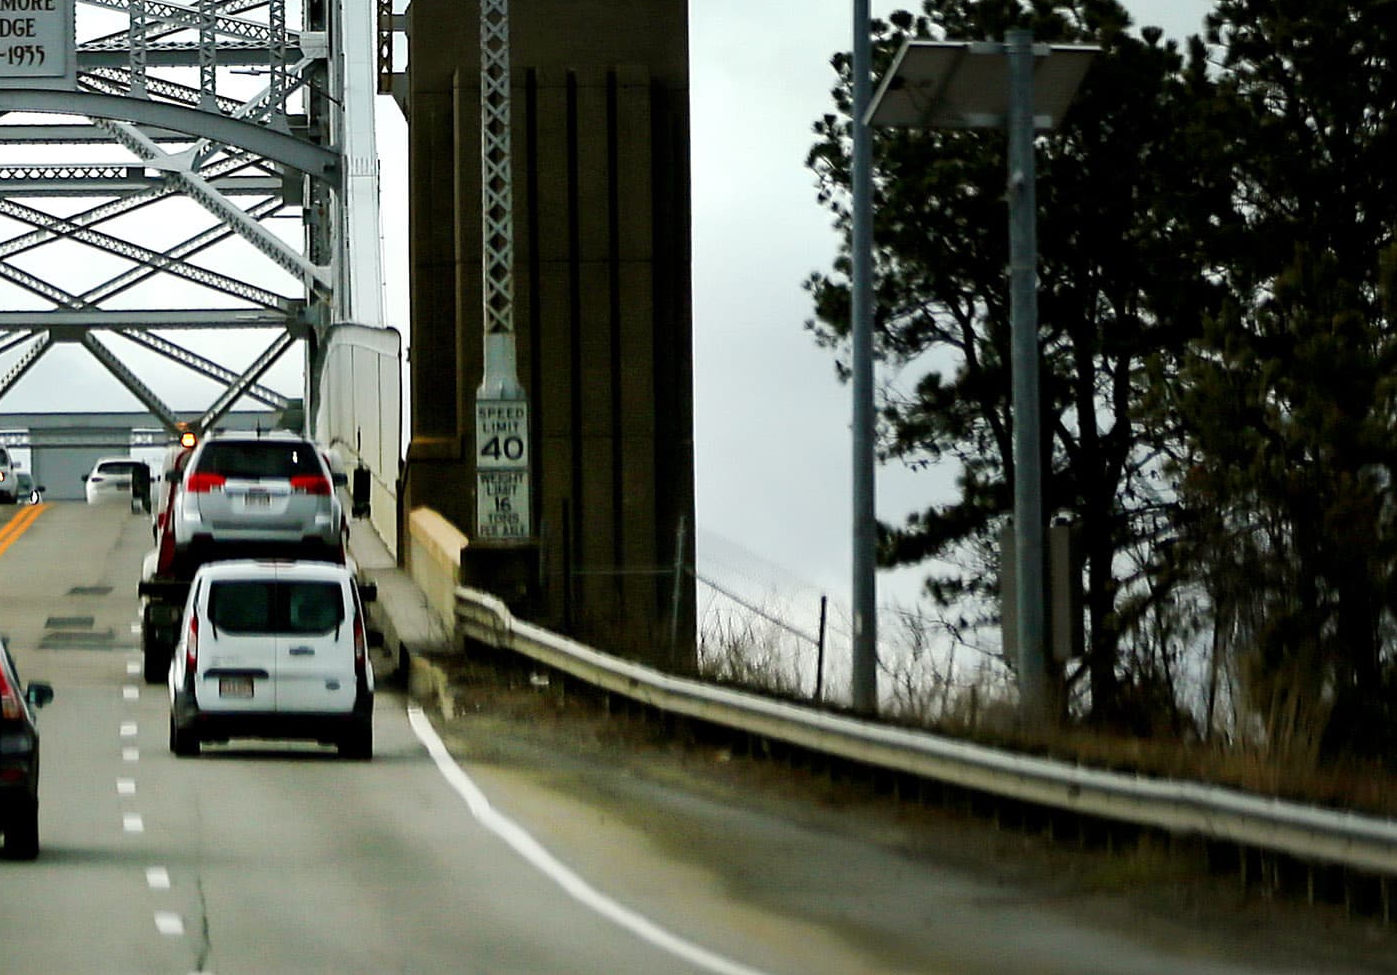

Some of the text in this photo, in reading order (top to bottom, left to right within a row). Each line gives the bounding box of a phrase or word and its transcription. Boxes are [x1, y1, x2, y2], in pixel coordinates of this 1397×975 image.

[479, 407, 524, 419] SPEED
[483, 421, 519, 433] LIMIT
[481, 435, 524, 461] 40
[480, 473, 523, 484] WEIGHT
[487, 484, 517, 496] LIMIT
[495, 496, 512, 512] 16
